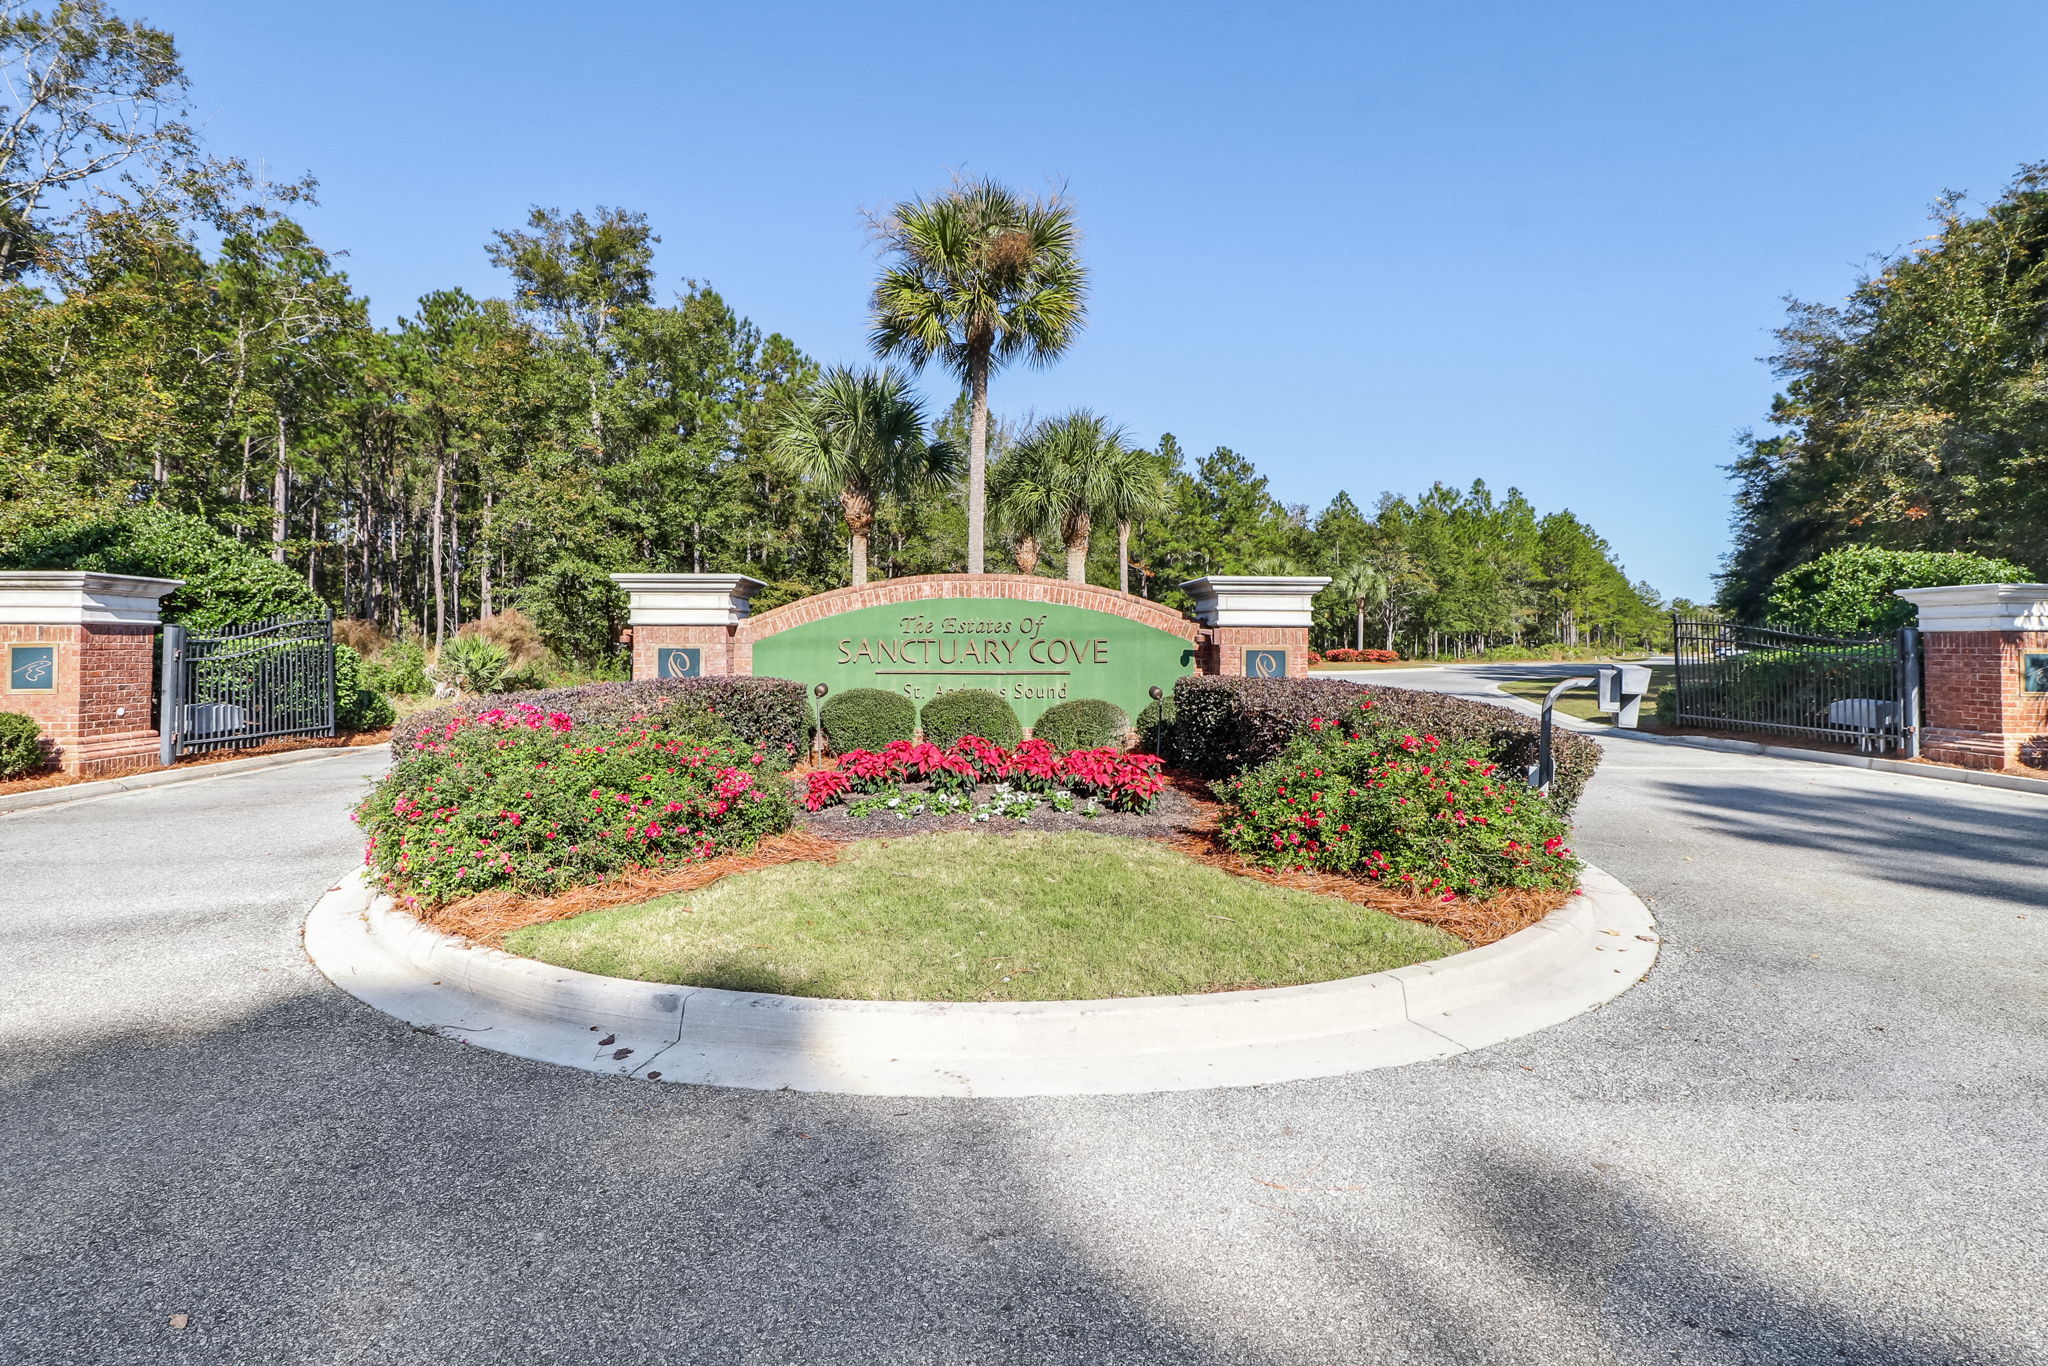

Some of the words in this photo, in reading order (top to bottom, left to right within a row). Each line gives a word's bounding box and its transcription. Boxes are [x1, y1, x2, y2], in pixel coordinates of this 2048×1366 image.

[899, 616, 934, 634] The
[941, 617, 1012, 634] Estates
[1019, 615, 1048, 640] Of
[837, 639, 1019, 664] SANCTUARY
[1029, 639, 1109, 664] COVE
[903, 682, 925, 699] St.
[1013, 682, 1068, 699] Sound
